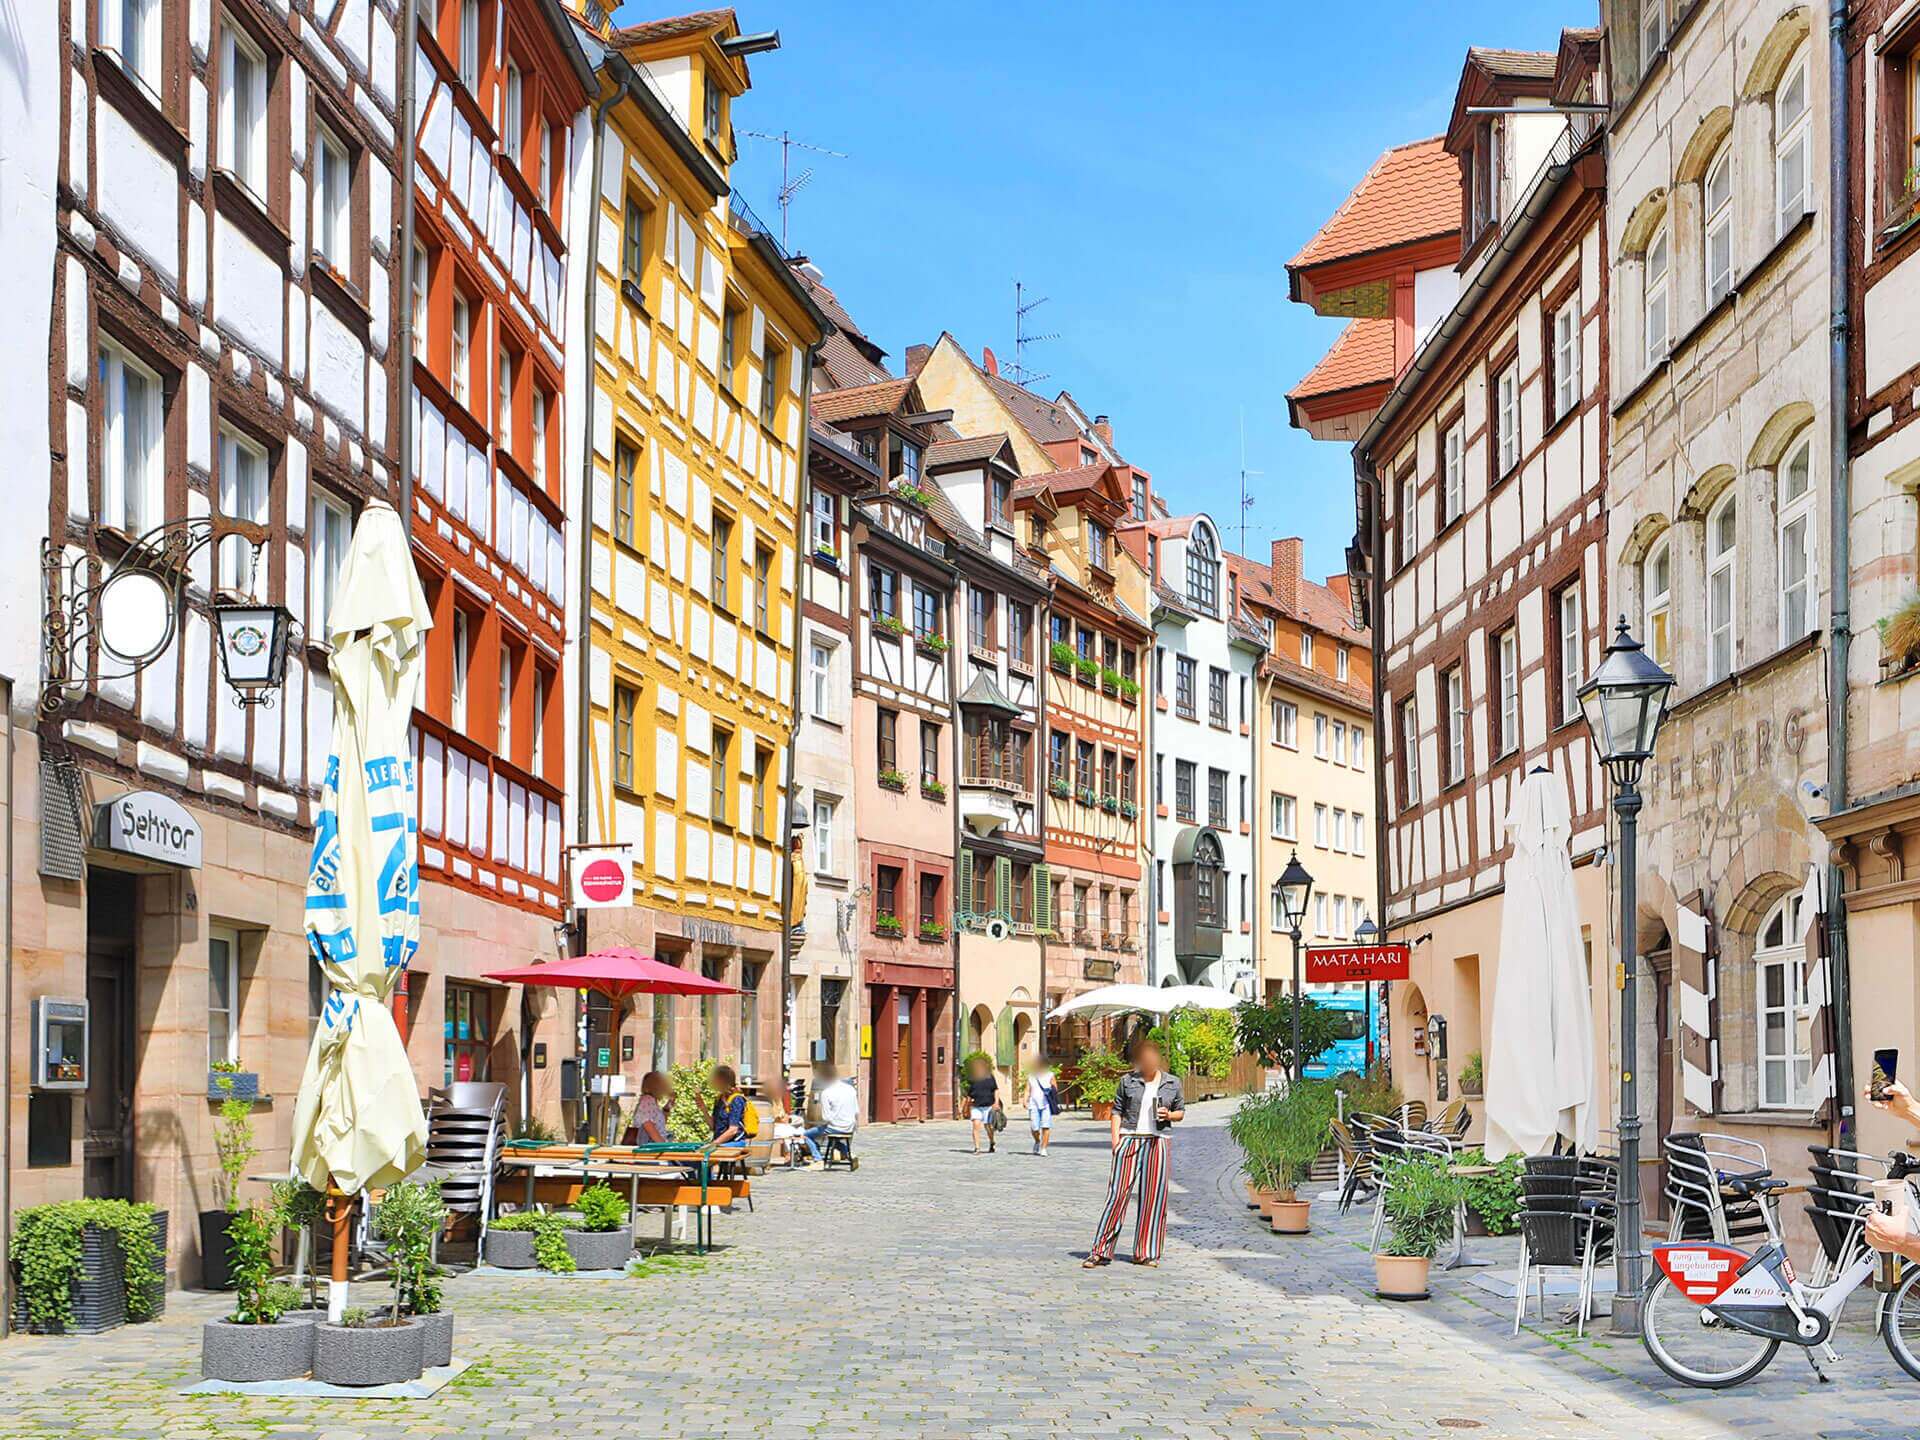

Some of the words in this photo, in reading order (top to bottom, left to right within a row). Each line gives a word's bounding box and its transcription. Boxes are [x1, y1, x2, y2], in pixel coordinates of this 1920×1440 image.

[1312, 953, 1360, 968] MATA
[1363, 951, 1401, 965] HARI
[1733, 1287, 1751, 1295] VAG
[1754, 1287, 1775, 1296] RAD
